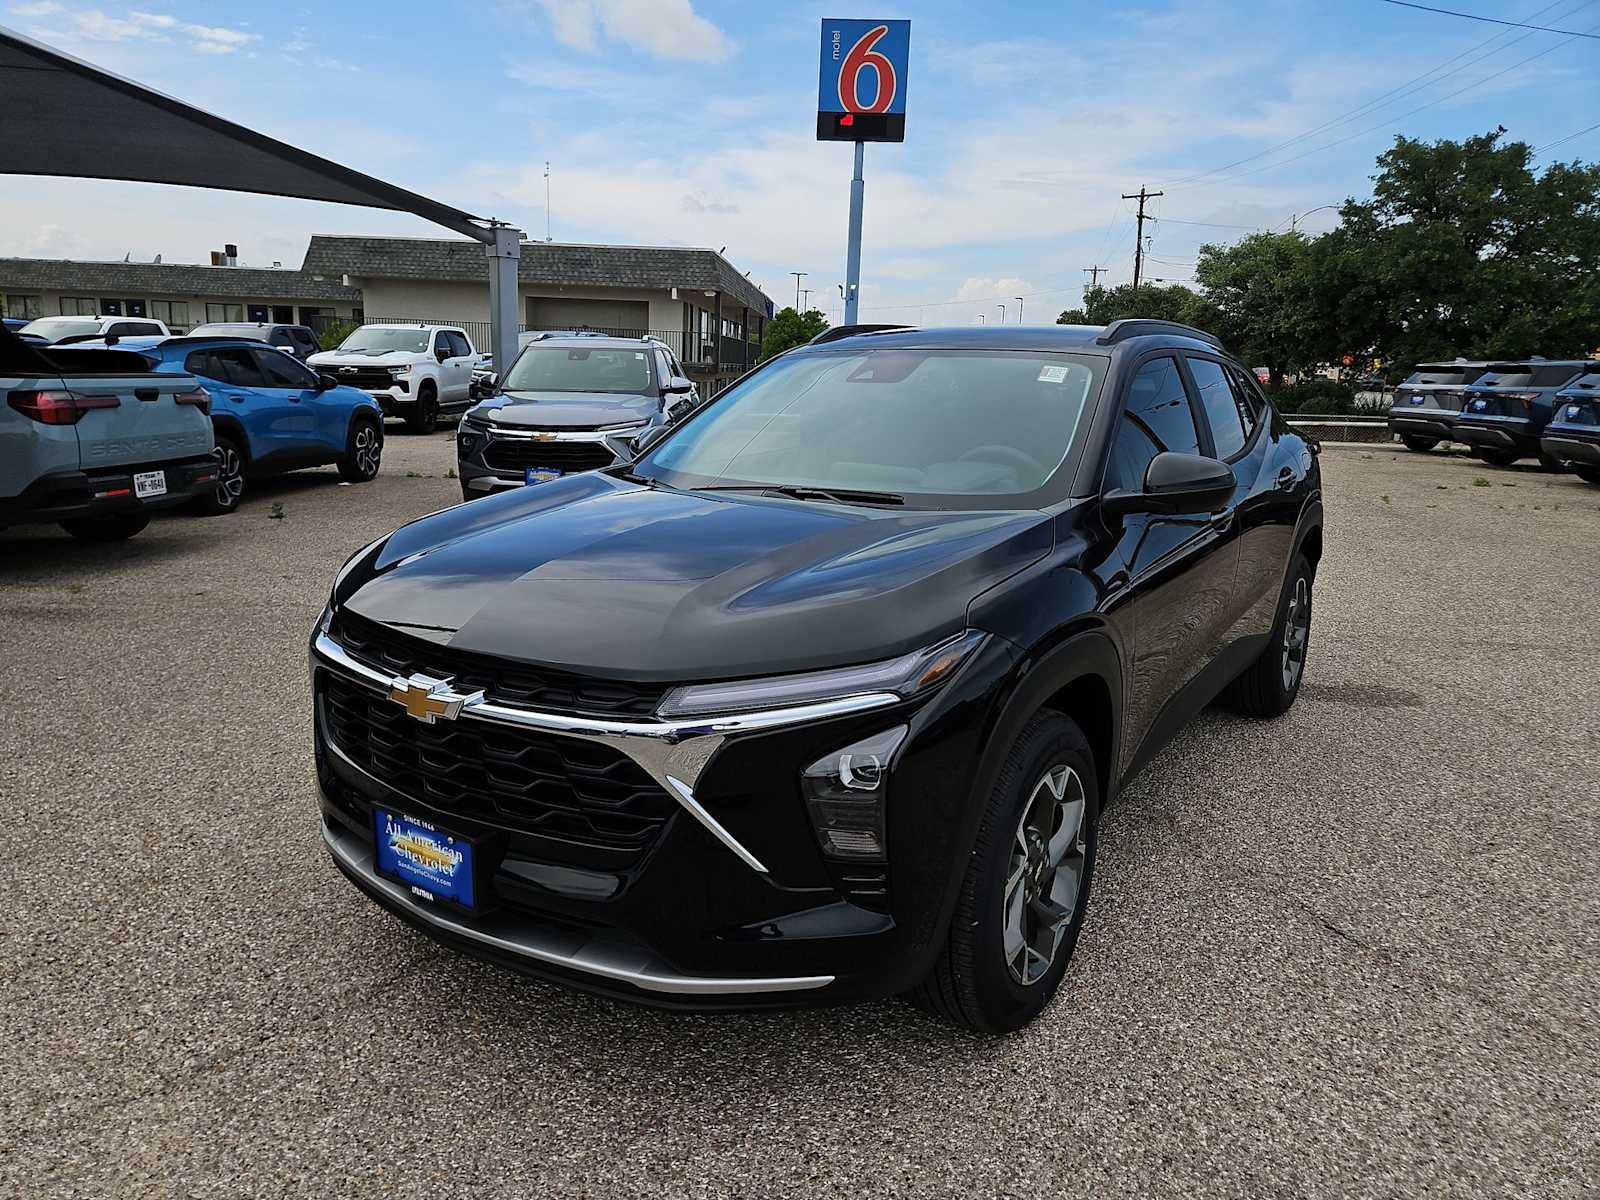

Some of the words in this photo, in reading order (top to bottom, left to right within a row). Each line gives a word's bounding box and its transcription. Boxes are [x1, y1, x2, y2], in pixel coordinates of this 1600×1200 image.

[832, 30, 841, 60] motel
[838, 25, 896, 113] 6
[403, 814, 421, 827] SINCE
[385, 821, 401, 838] All
[406, 829, 463, 863] American
[395, 842, 455, 877] Chevrolet
